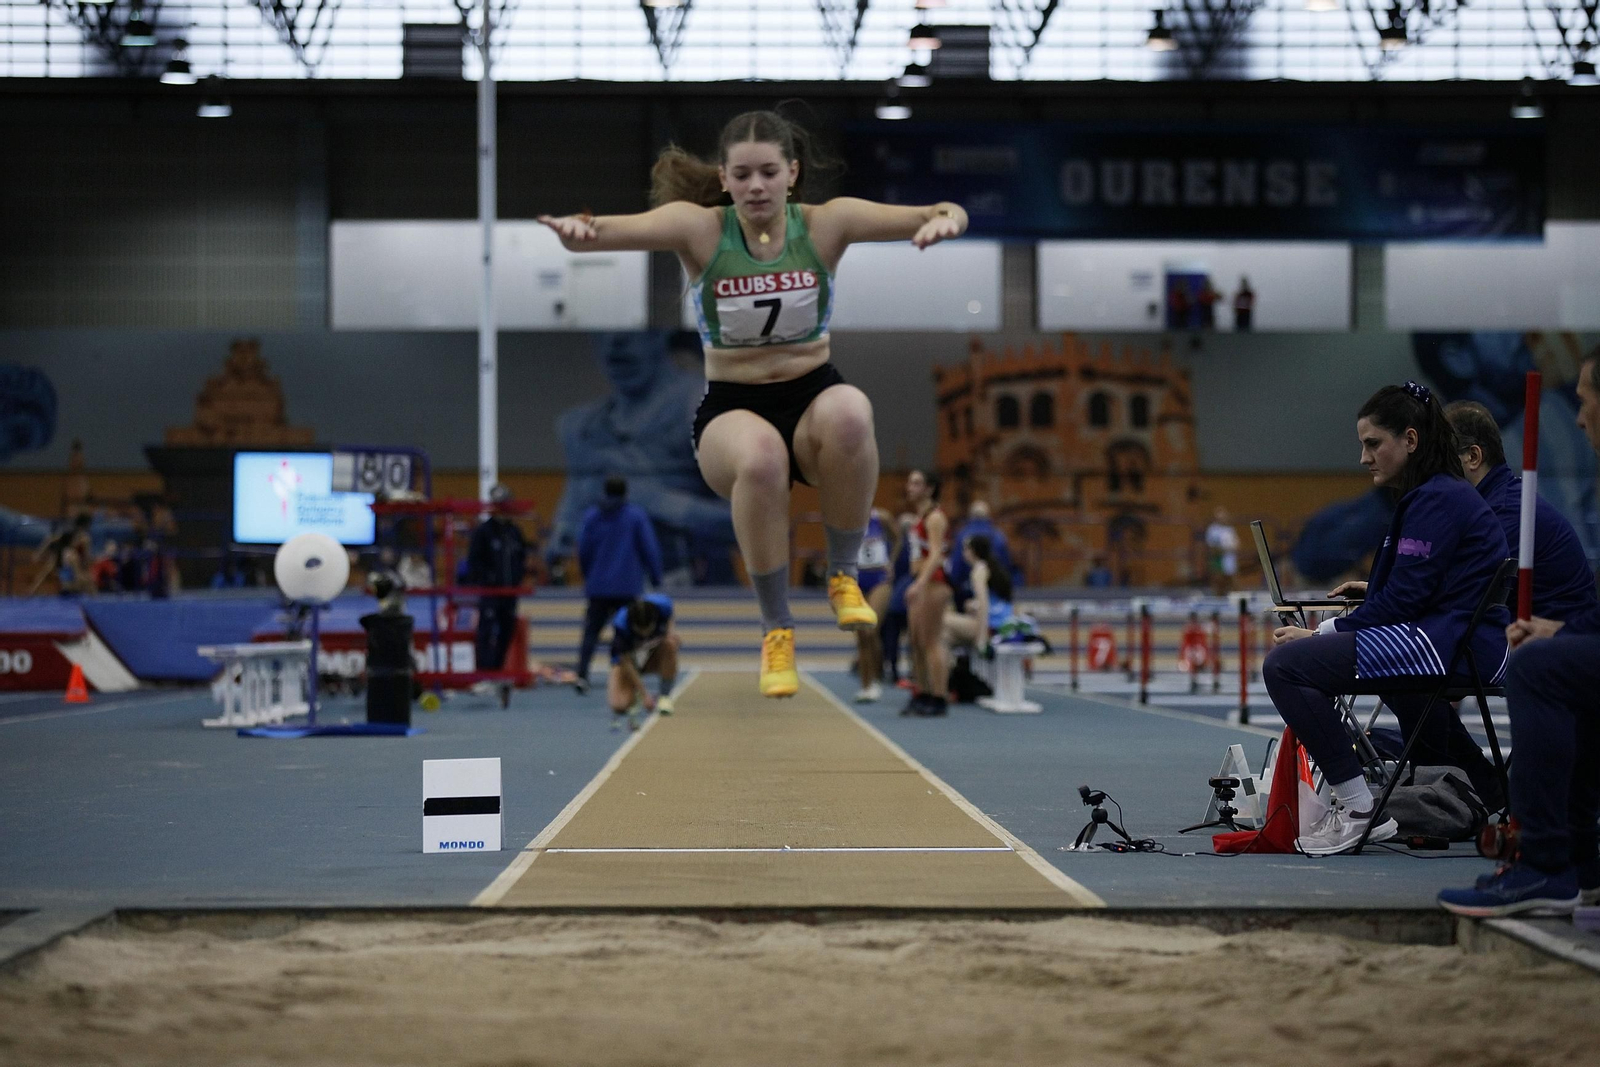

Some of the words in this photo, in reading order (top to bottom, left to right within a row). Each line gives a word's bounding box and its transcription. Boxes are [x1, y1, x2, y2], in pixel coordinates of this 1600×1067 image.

[1061, 160, 1338, 206] OURENSE
[717, 276, 777, 297] CLUBS
[780, 270, 815, 290] S16
[754, 298, 782, 337] 7
[439, 841, 485, 849] MONDO
